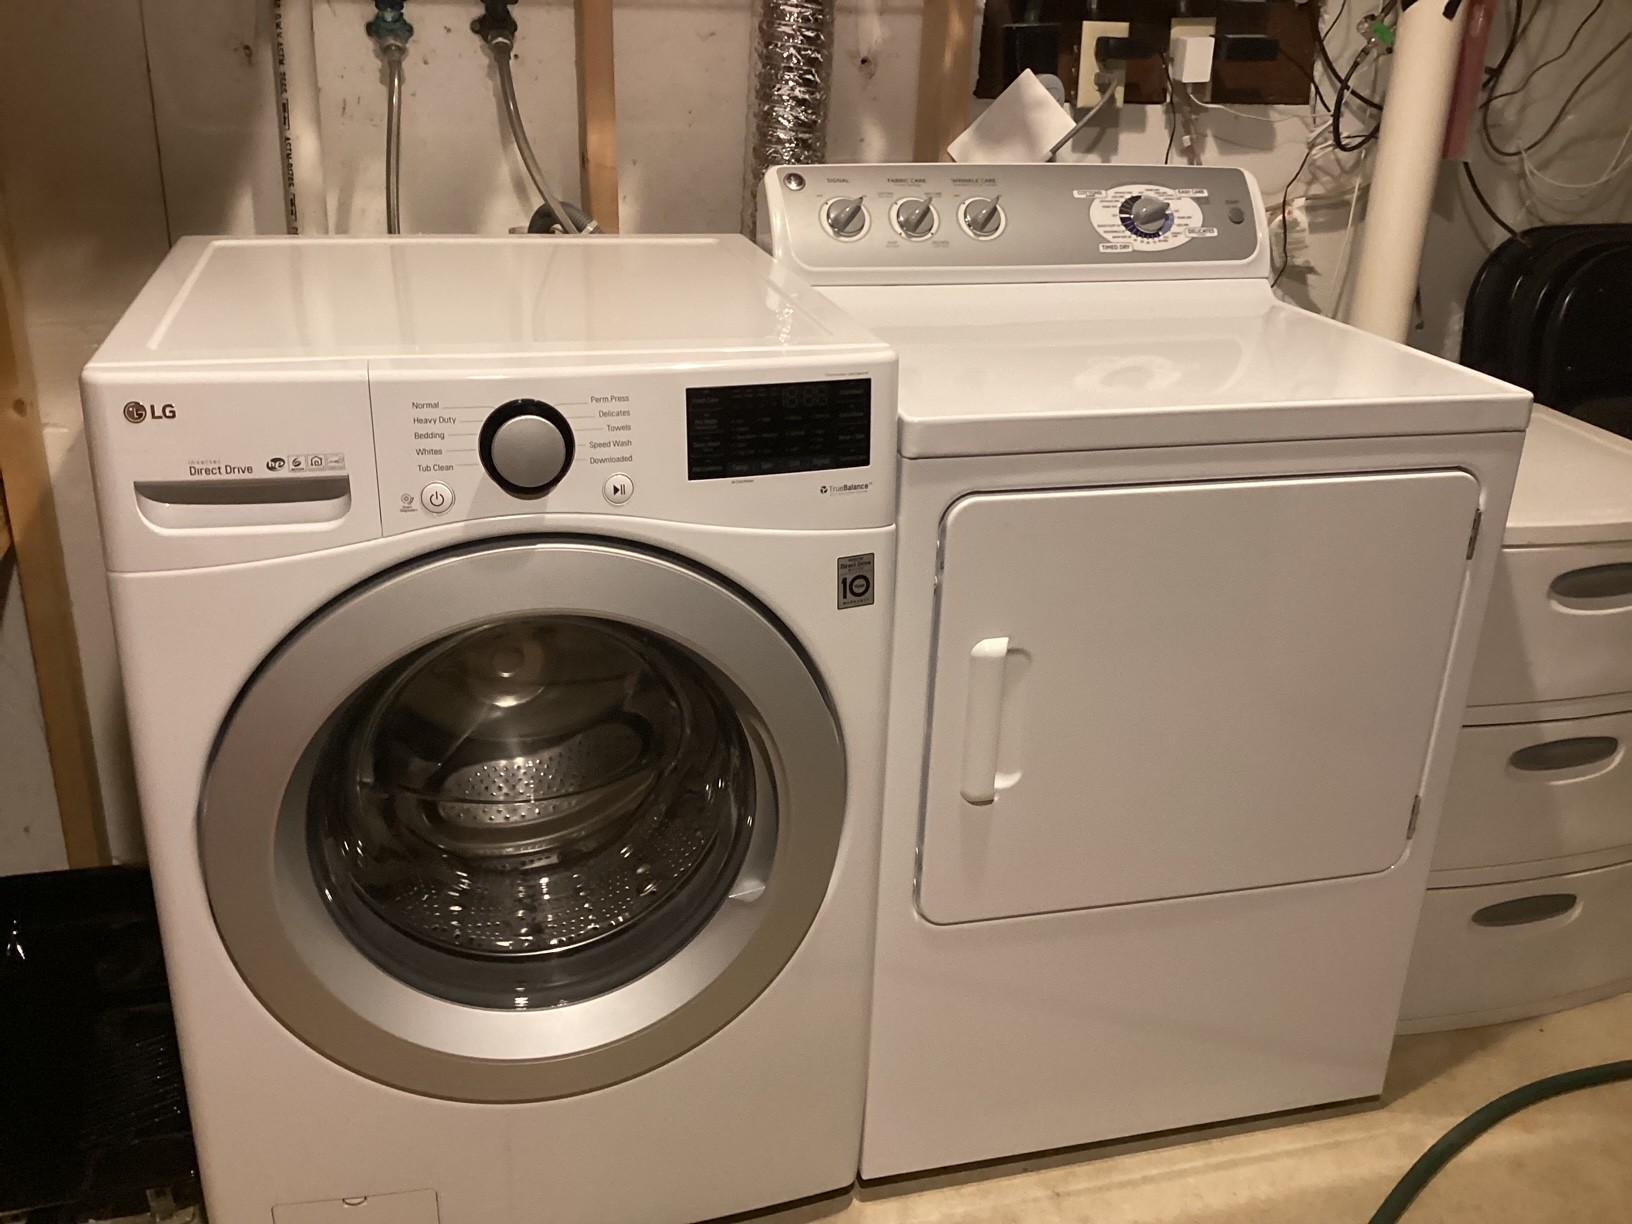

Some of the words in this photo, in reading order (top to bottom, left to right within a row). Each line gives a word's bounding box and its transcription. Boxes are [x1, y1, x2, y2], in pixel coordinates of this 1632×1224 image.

[590, 396, 608, 404] Perm
[609, 395, 630, 403] Press
[412, 401, 440, 410] Normal
[151, 404, 177, 419] LG
[598, 409, 631, 418] Delicates
[413, 416, 437, 425] Heavy
[439, 416, 456, 425] Duty
[606, 424, 631, 432] Towels
[414, 431, 445, 440] Bedding
[589, 440, 612, 450] Speed
[613, 439, 632, 448] Wash
[416, 448, 443, 456] Whites
[589, 455, 633, 465] Downloaded
[189, 465, 222, 477] Direct
[225, 464, 253, 475] Drive
[418, 464, 431, 472] Tub
[433, 464, 454, 472] Clean
[829, 483, 869, 492] TrueBalance
[841, 574, 871, 599] 10
